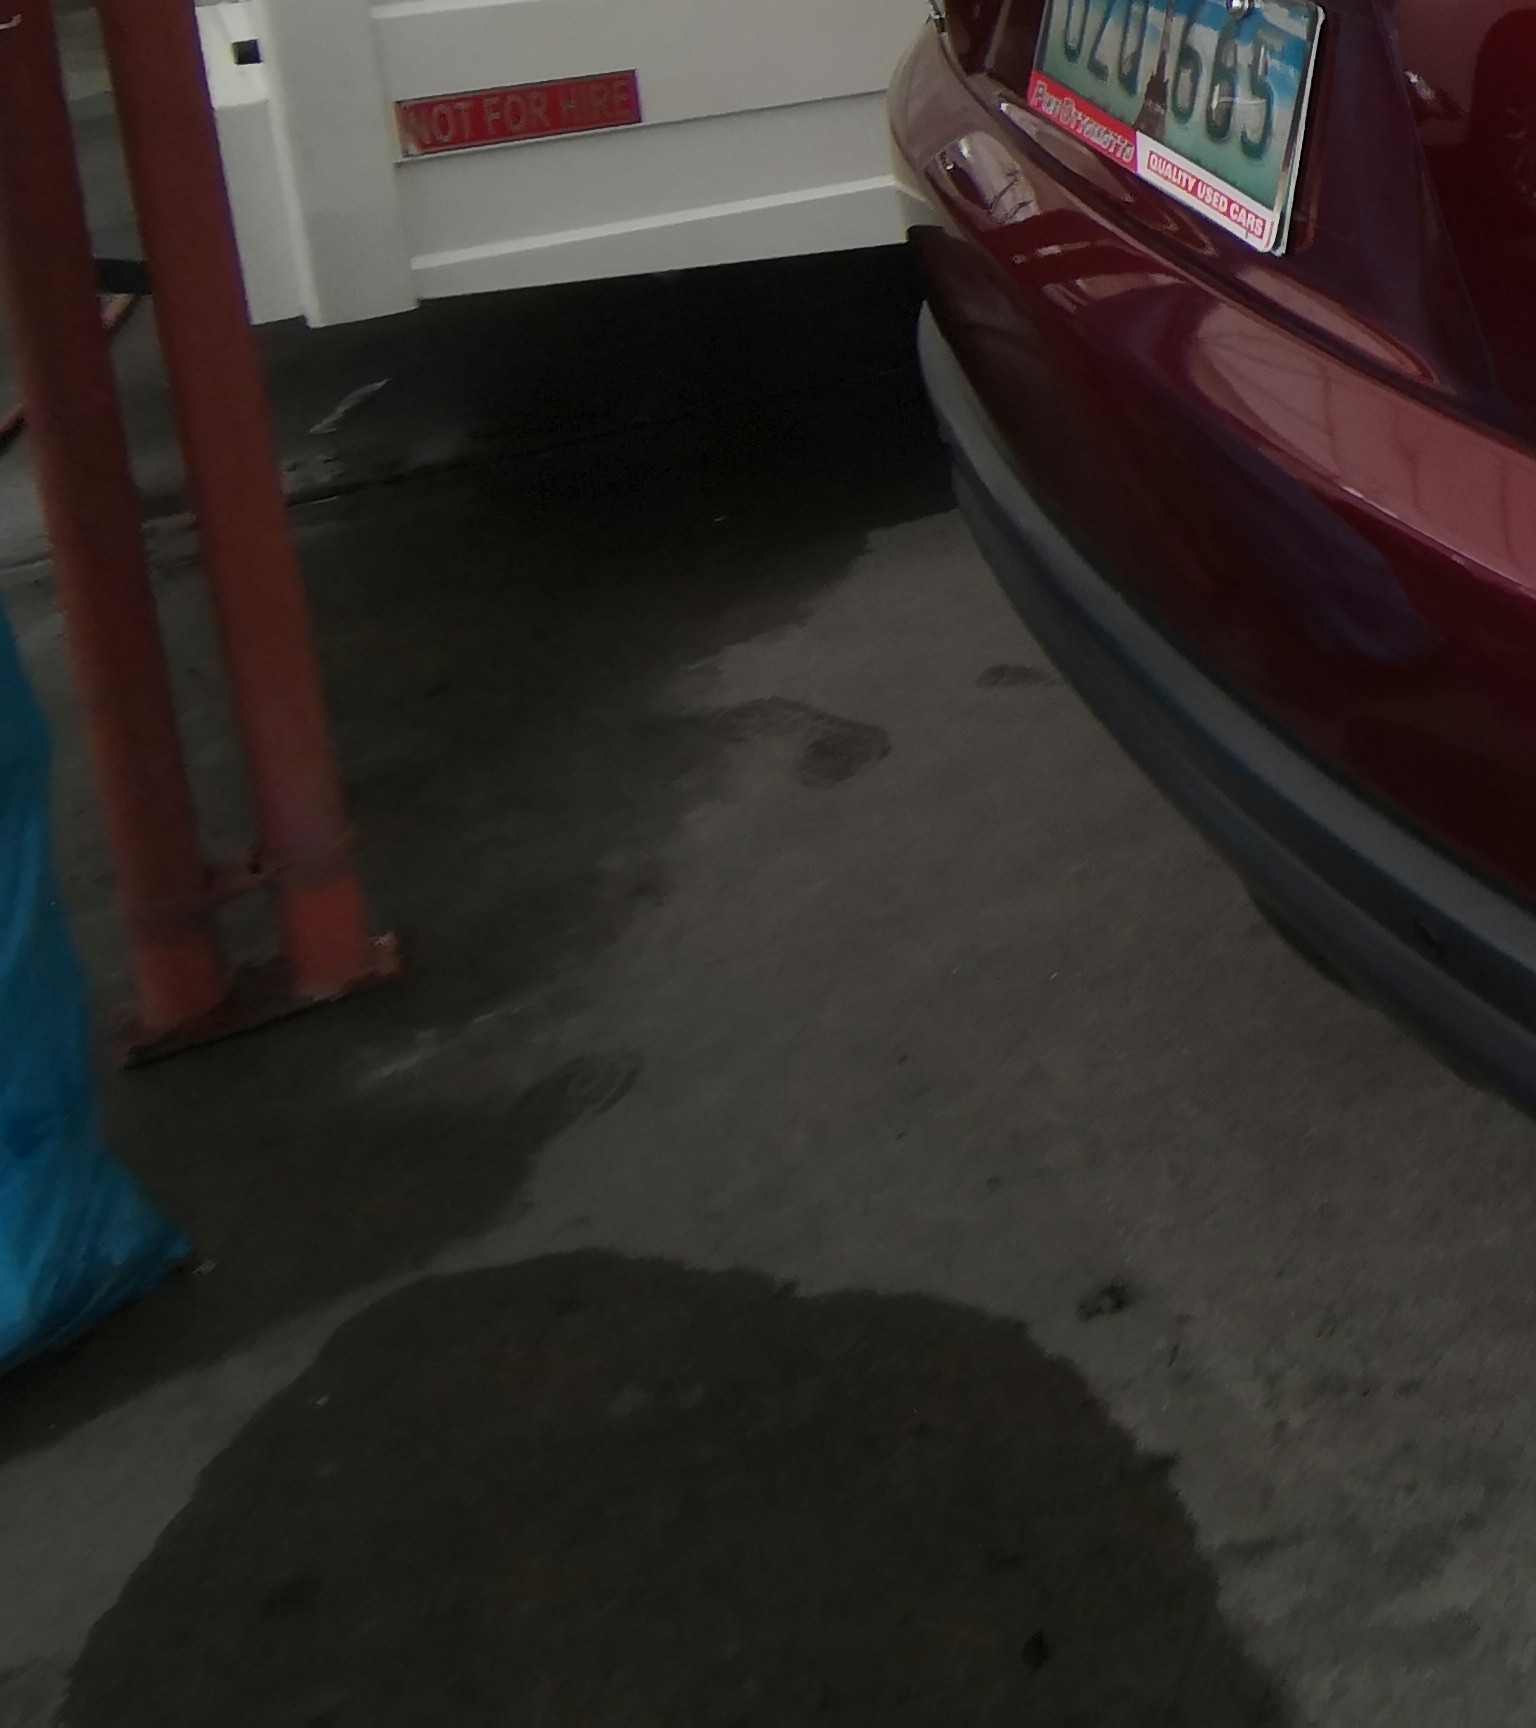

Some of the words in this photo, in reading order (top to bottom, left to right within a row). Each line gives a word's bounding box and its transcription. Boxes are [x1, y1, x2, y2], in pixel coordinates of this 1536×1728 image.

[482, 90, 552, 134] FOR
[1148, 153, 1198, 192] QUALITY
[1196, 181, 1230, 212] USED
[1228, 202, 1265, 238] CARS
